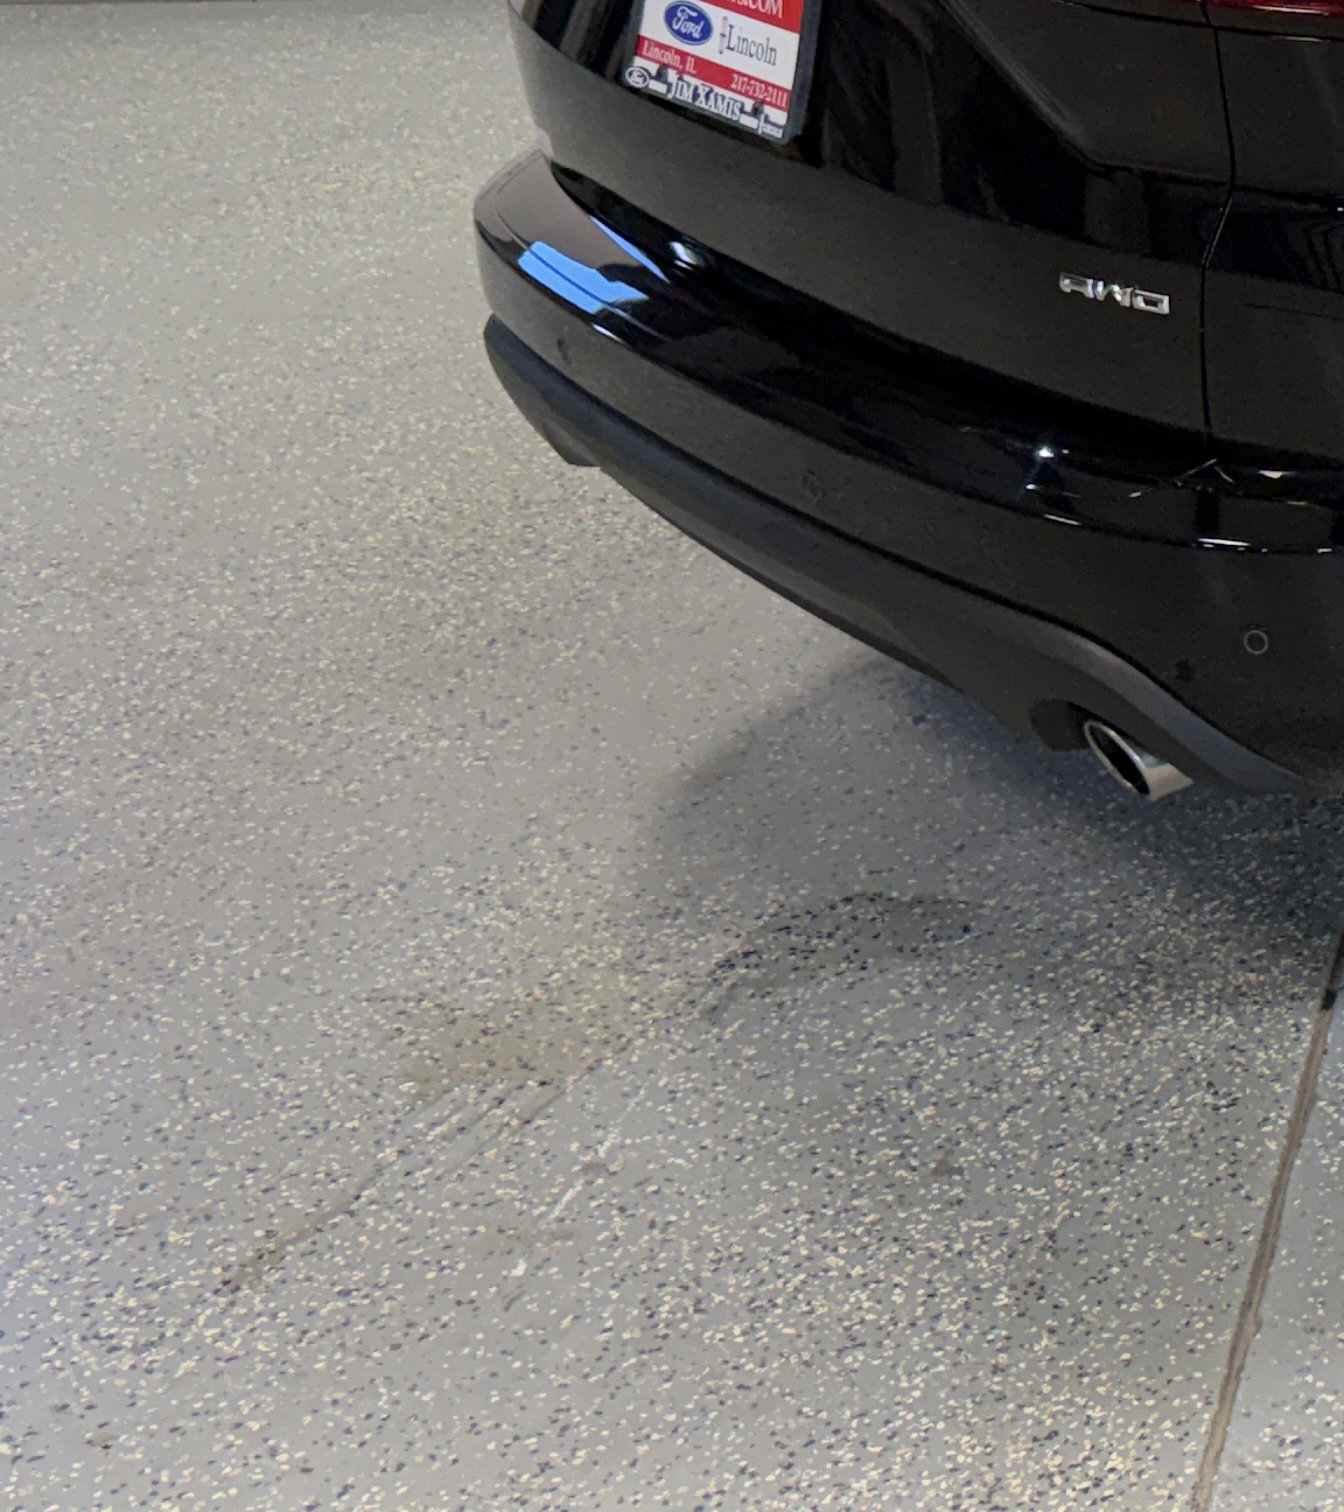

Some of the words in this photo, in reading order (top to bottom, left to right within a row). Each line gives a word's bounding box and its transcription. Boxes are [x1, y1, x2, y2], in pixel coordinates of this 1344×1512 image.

[671, 5, 705, 39] Ford
[726, 24, 778, 67] Lincoln
[1059, 272, 1171, 315] AWD
